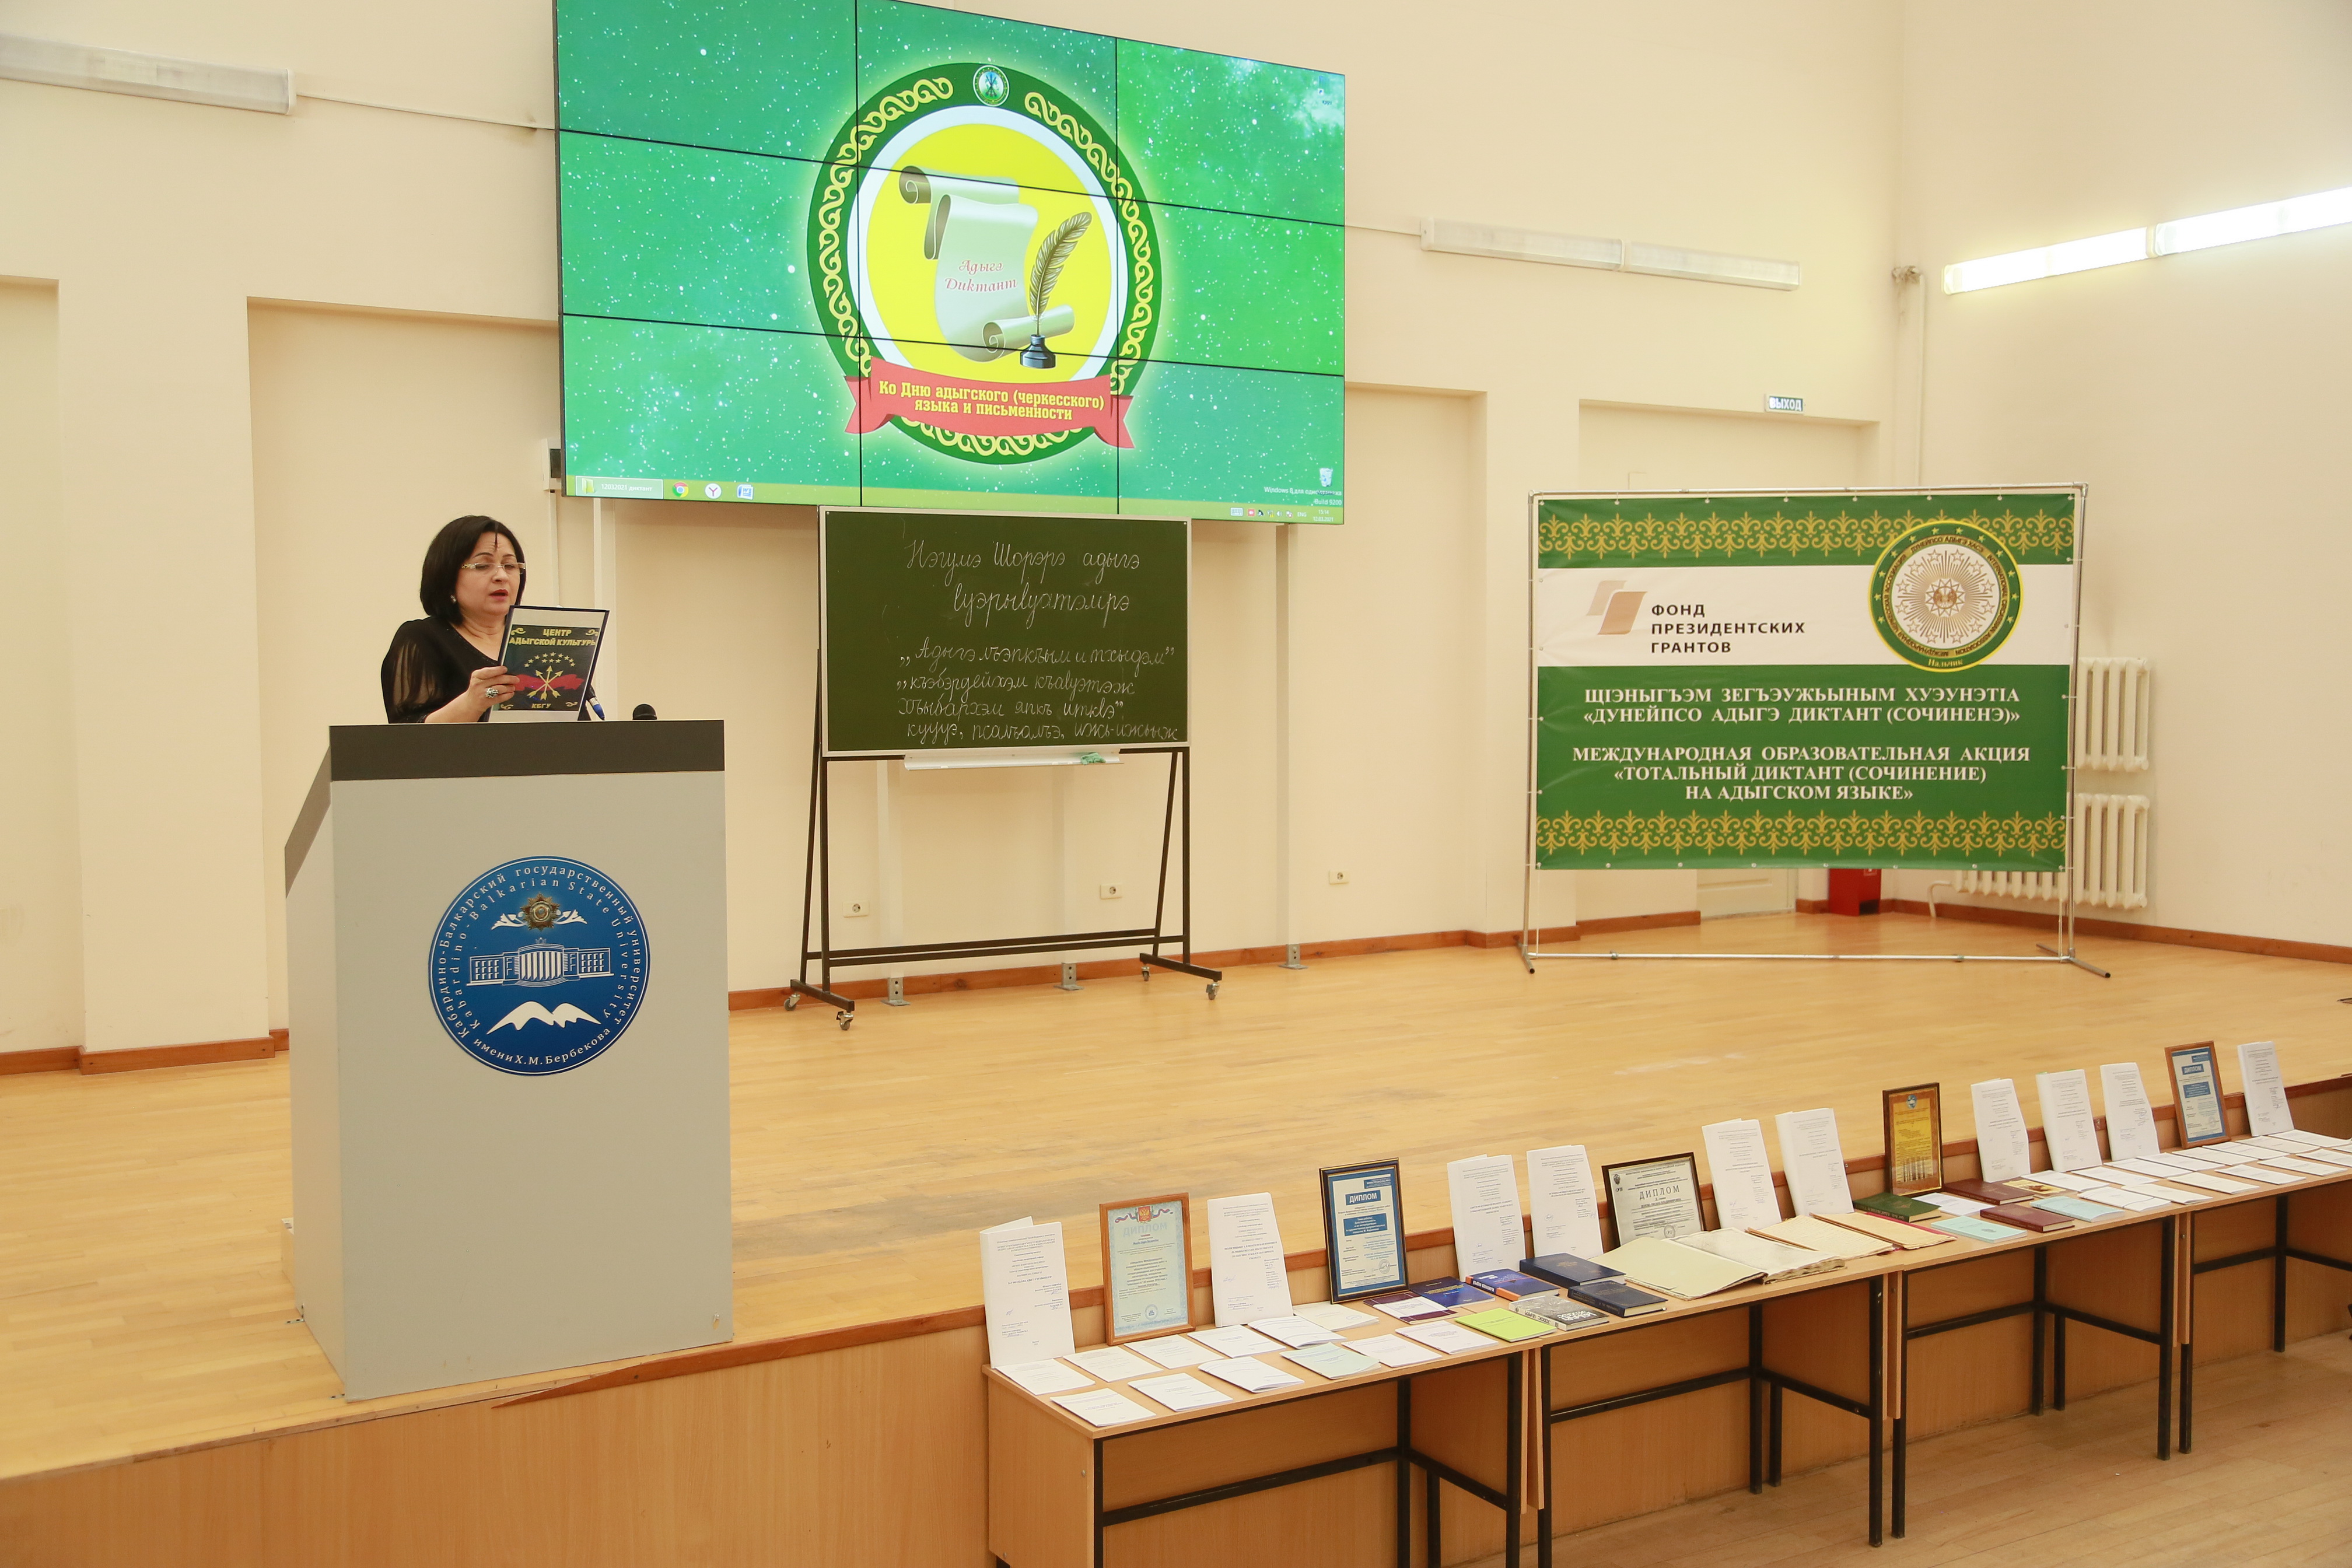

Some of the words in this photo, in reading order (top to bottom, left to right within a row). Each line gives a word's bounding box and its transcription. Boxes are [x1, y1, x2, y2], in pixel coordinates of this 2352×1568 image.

[959, 260, 1004, 275] Адыгэ
[945, 278, 1017, 292] Диктант
[879, 380, 897, 395] Ко
[901, 382, 931, 397] Дню
[935, 386, 1009, 403] адыгского
[1013, 389, 1105, 411] (черкесского)
[914, 399, 959, 414] языка
[963, 402, 972, 414] и
[976, 403, 1073, 420] письменности
[1769, 397, 1802, 411] ВЫХОД
[1945, 536, 1967, 545] АДЫГЭ
[1968, 541, 1984, 554] ХАСЭ
[1083, 552, 1140, 584] адыгэ
[1986, 554, 2008, 597] INTERNATIONAL
[1651, 604, 1705, 618] ФОНД
[542, 628, 572, 636] ЦЕНТР
[1651, 622, 1805, 636] ПРЕЗИДЕНТСКИХ
[509, 637, 555, 645] АДЫГСКОЙ
[1651, 642, 1731, 653] ГРАНТОВ
[1721, 688, 1895, 702] ЗЕГЪЭУЖЬЫНЫМ
[1584, 705, 1702, 724] «ДУНЕЙПСО
[1712, 708, 1780, 724] АДЫГЭ
[1788, 707, 1882, 724] ДИКТАНТ
[1887, 707, 2021, 724] (СОЧИНЕНЭ)»
[1573, 747, 1751, 764] МЕЖДУНАРОДНАЯ
[1761, 747, 1950, 761] ОБРАЗОВАТЕЛЬНАЯ
[1960, 747, 2030, 764] АКЦИЯ
[1614, 762, 1747, 781] «ТОТАЛЬНЫЙ
[1751, 766, 1844, 783] ДИКТАНТ
[1849, 766, 1987, 783] (СОЧИНЕНИЕ)
[1685, 786, 1712, 800] НА
[1717, 785, 1831, 802] АДЫГСКОМ
[1836, 785, 1913, 800] ЯЗЫКЕ»
[439, 873, 506, 1038] Кабардино-Балкарский
[516, 865, 632, 925] государственный
[613, 929, 642, 1025] университет
[568, 880, 610, 914] State
[603, 918, 629, 1019] University
[1349, 1193, 1377, 1204] ДИПЛОМ
[1639, 1185, 1679, 1200] ДИПЛОМ
[1124, 1223, 1167, 1237] ДИПЛОМ
